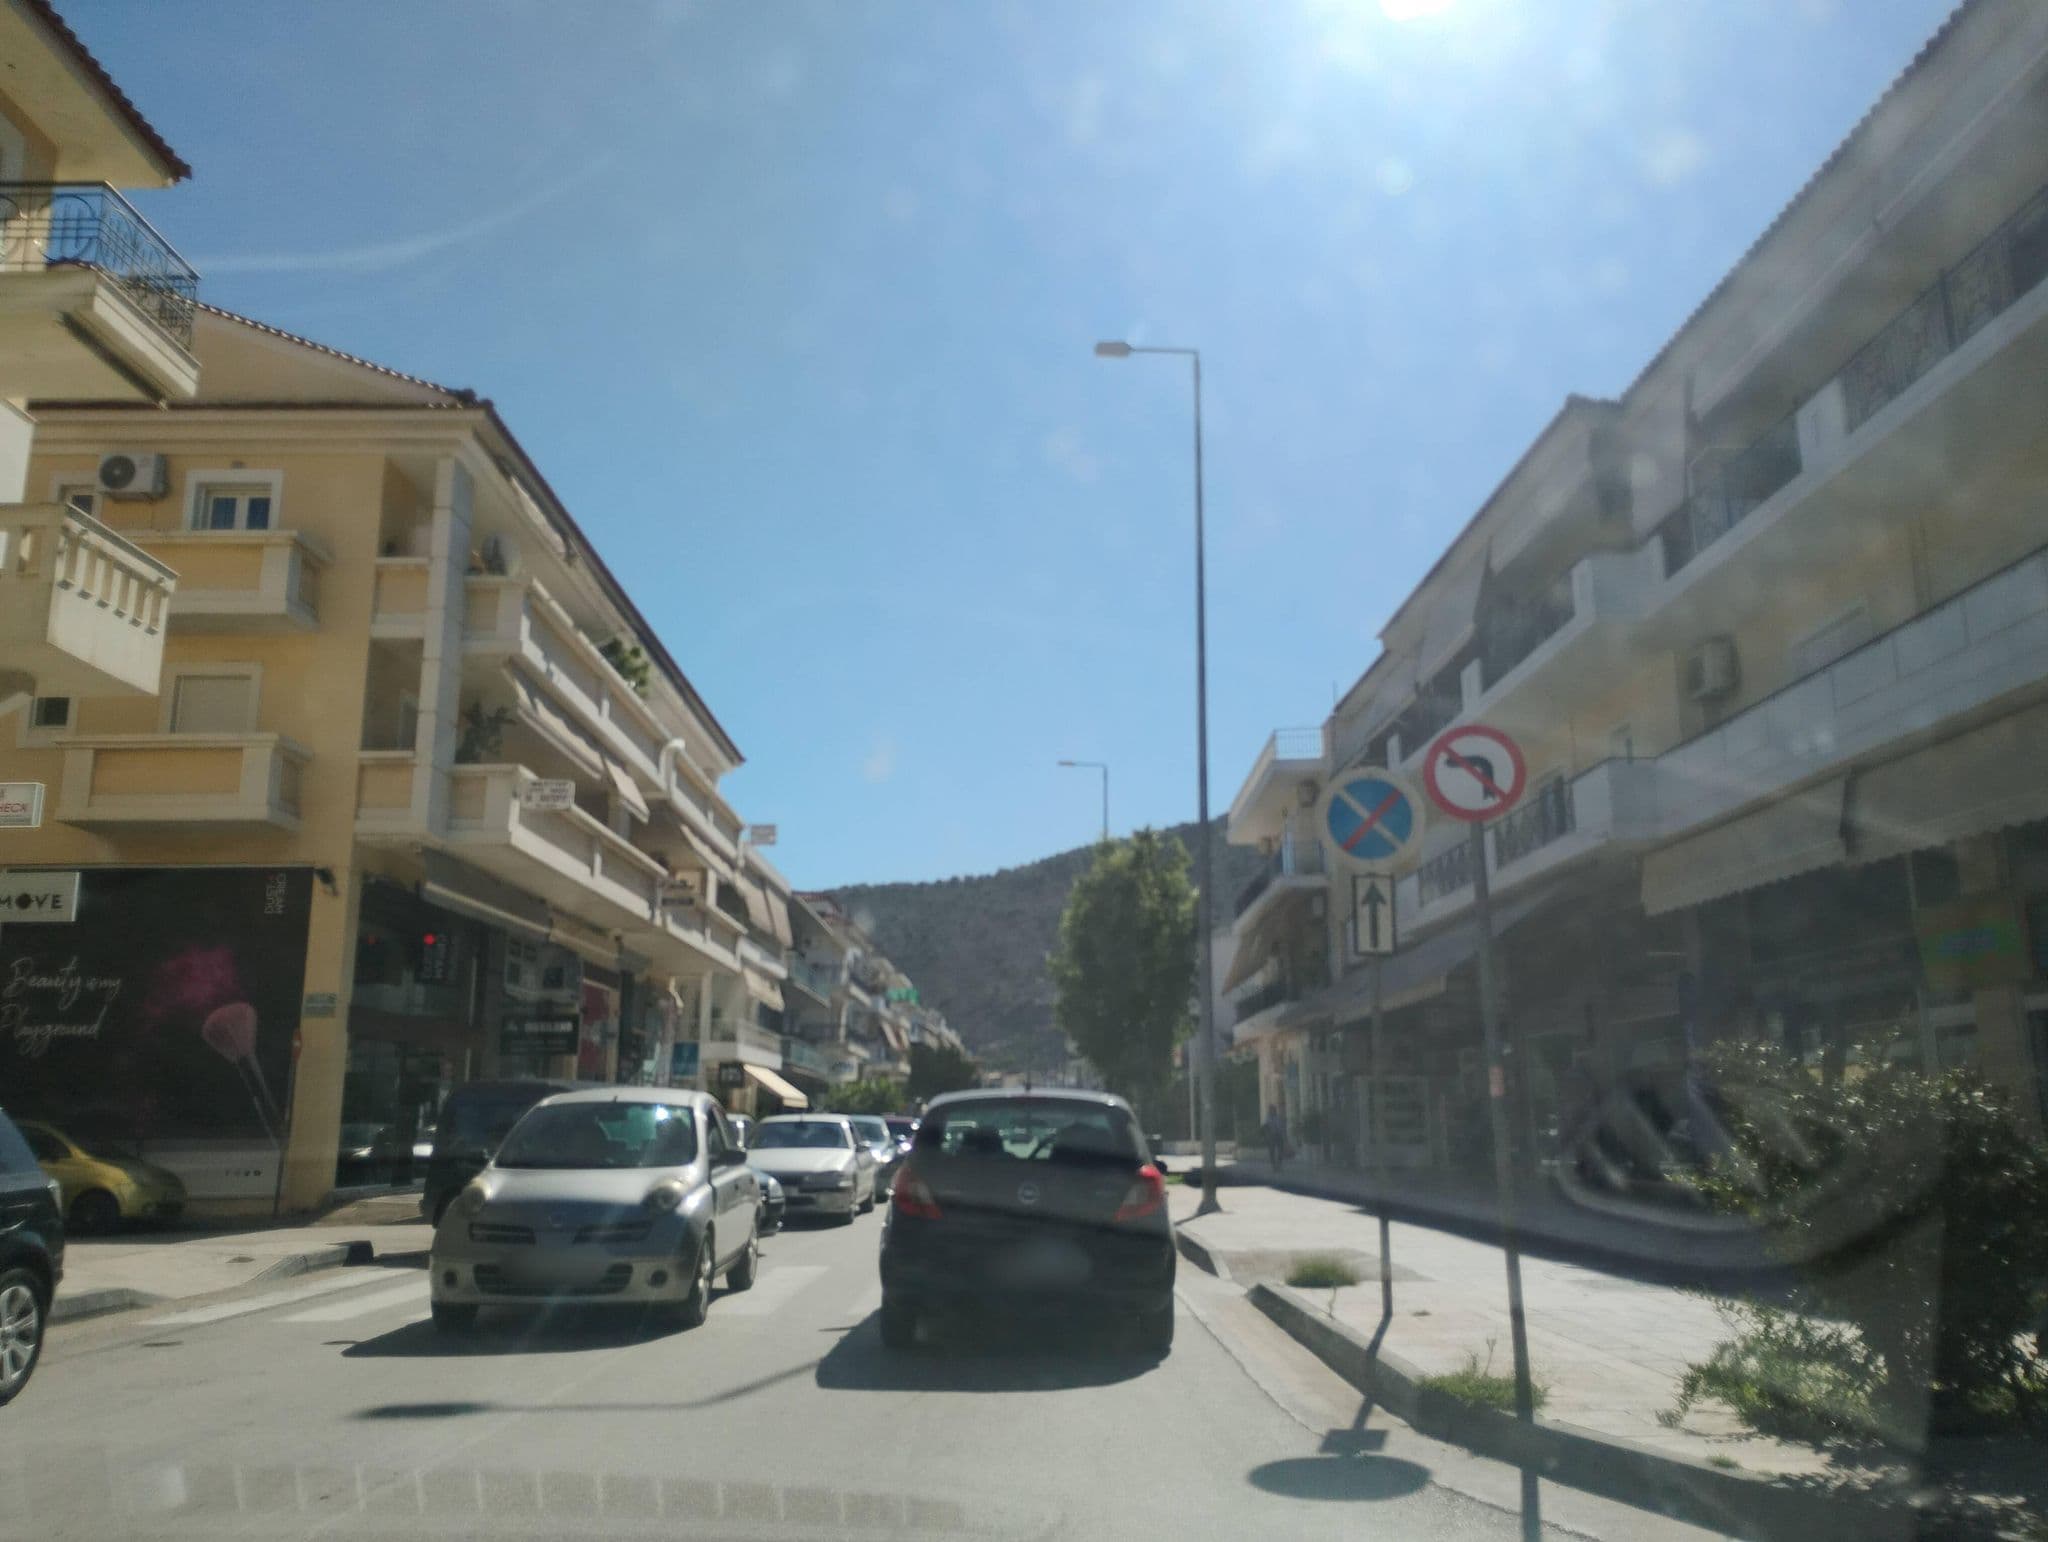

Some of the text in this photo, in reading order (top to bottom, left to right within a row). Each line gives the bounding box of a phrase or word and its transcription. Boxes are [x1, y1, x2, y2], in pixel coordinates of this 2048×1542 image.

[2, 956, 81, 1011] Beauty
[98, 977, 121, 1003] my
[0, 1003, 107, 1058] Playground
